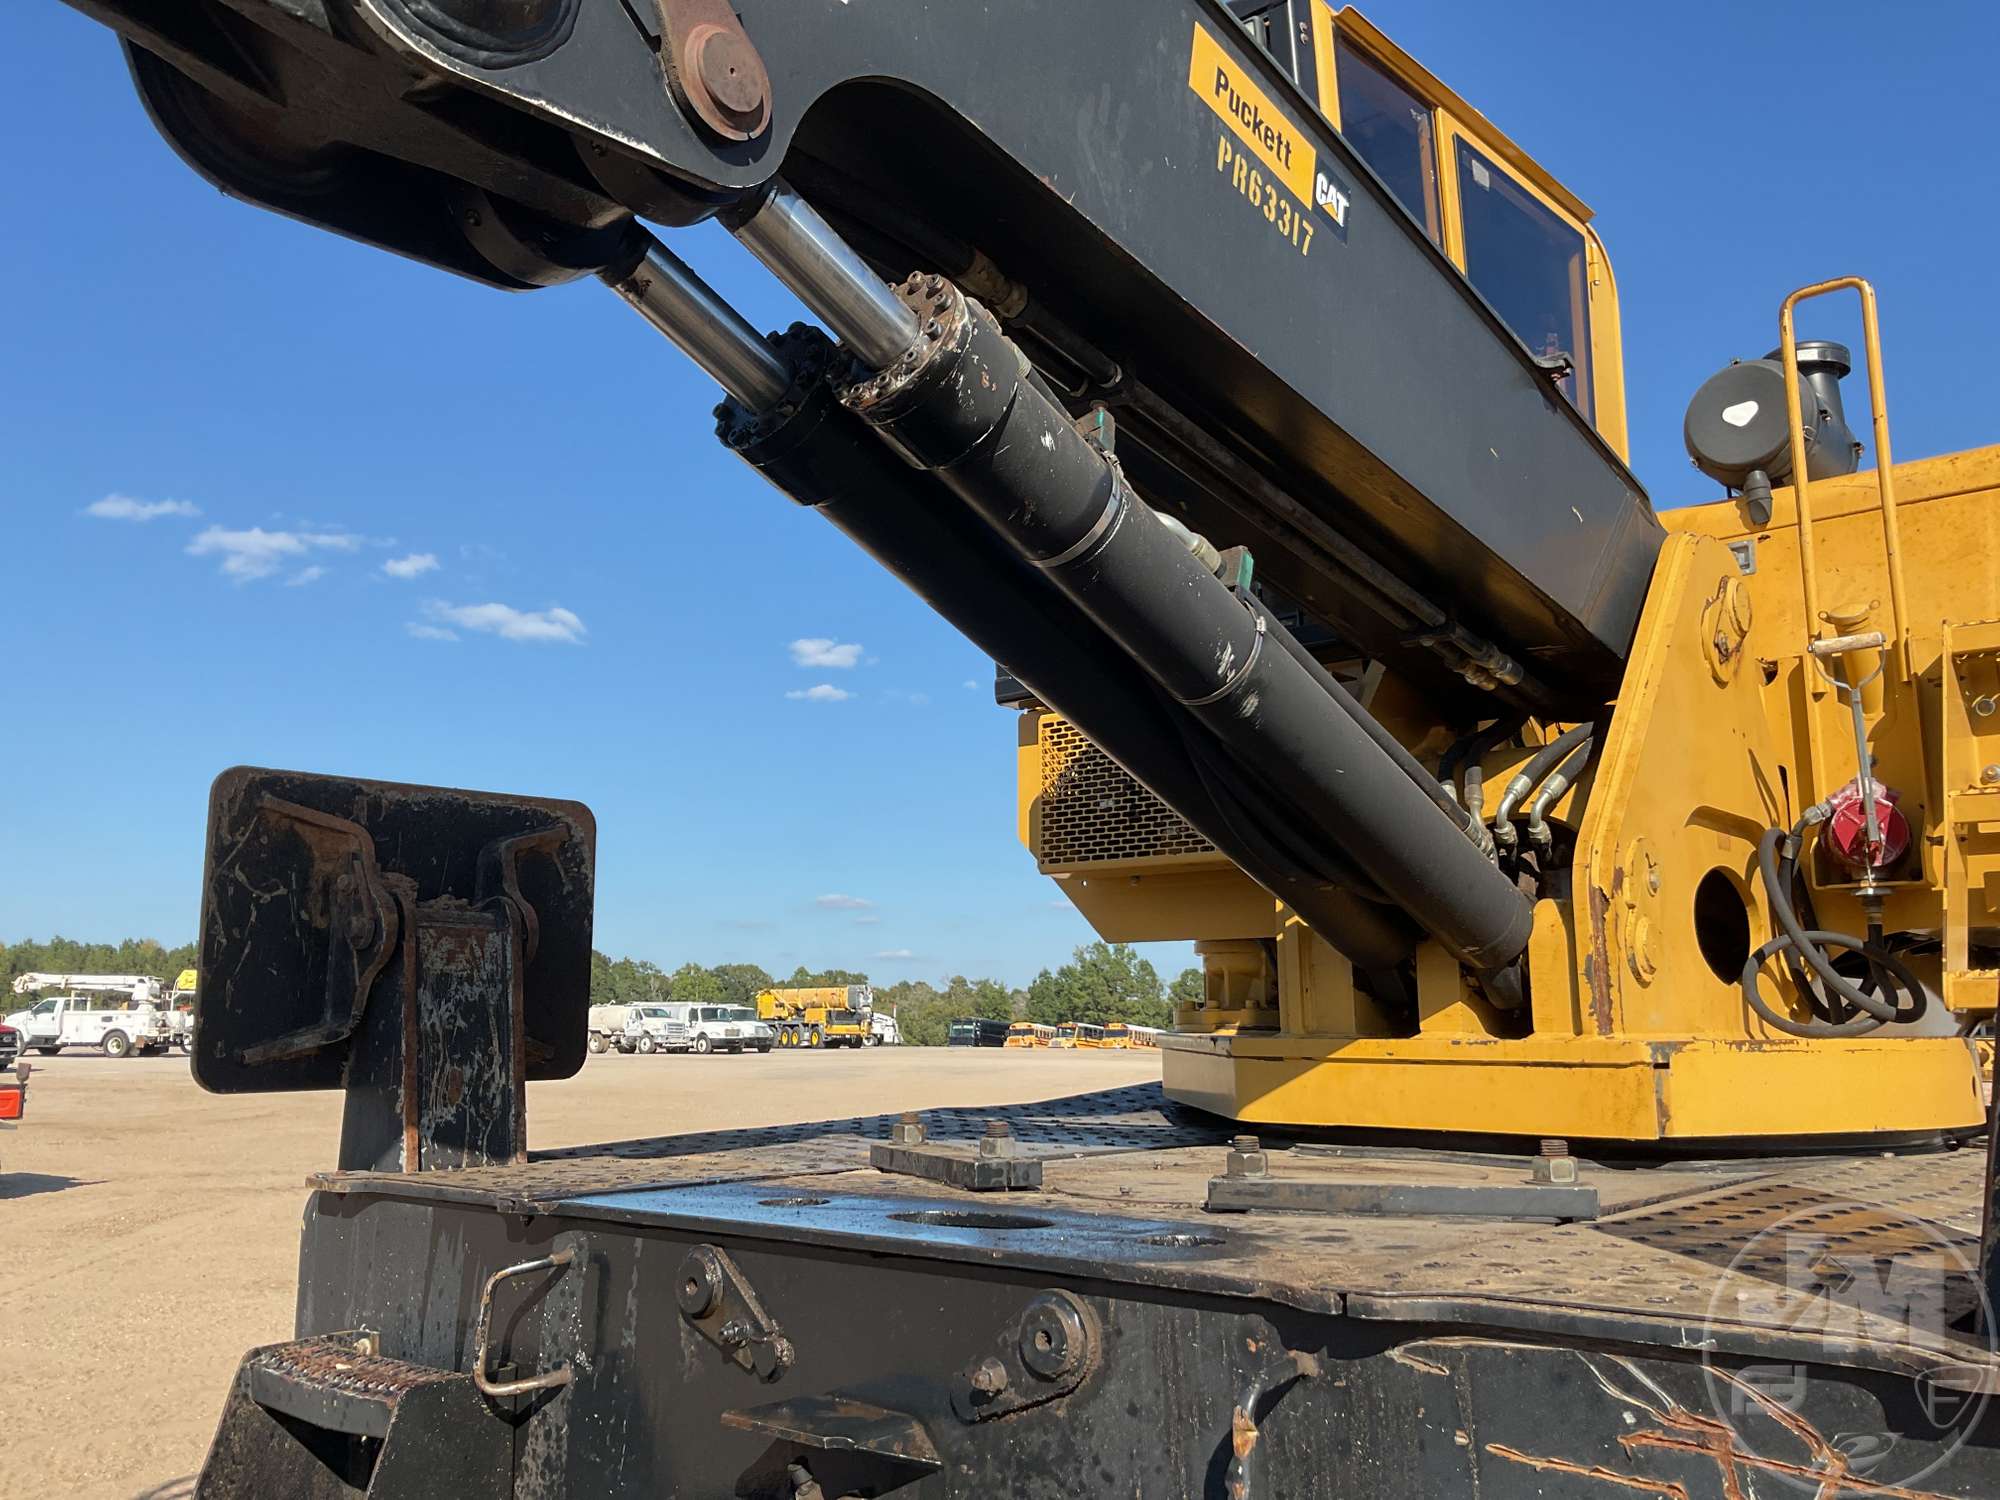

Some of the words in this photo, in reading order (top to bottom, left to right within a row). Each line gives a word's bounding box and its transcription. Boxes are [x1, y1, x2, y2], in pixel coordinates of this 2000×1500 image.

[1214, 66, 1292, 170] Puckett
[1315, 172, 1349, 227] CAT
[1217, 136, 1314, 256] PR63317
